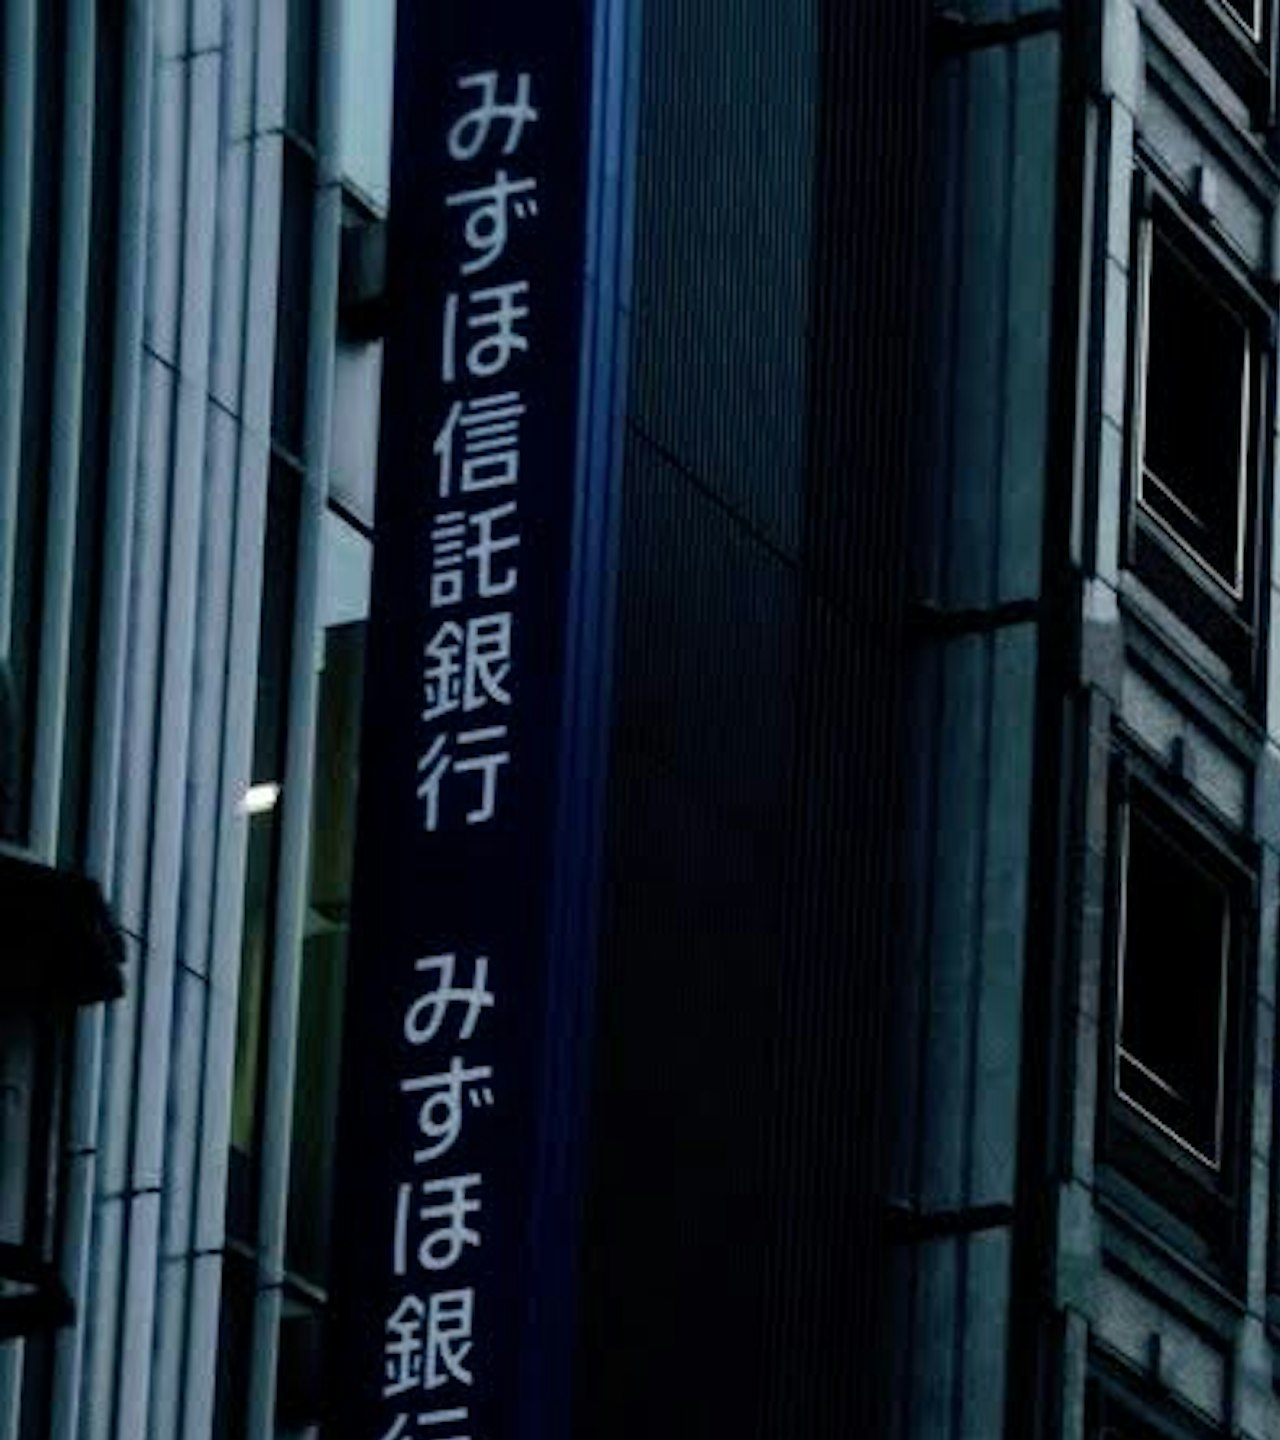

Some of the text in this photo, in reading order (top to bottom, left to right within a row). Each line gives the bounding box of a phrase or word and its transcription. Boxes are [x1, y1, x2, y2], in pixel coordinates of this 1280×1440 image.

[415, 66, 541, 834] みずほ信託銀行
